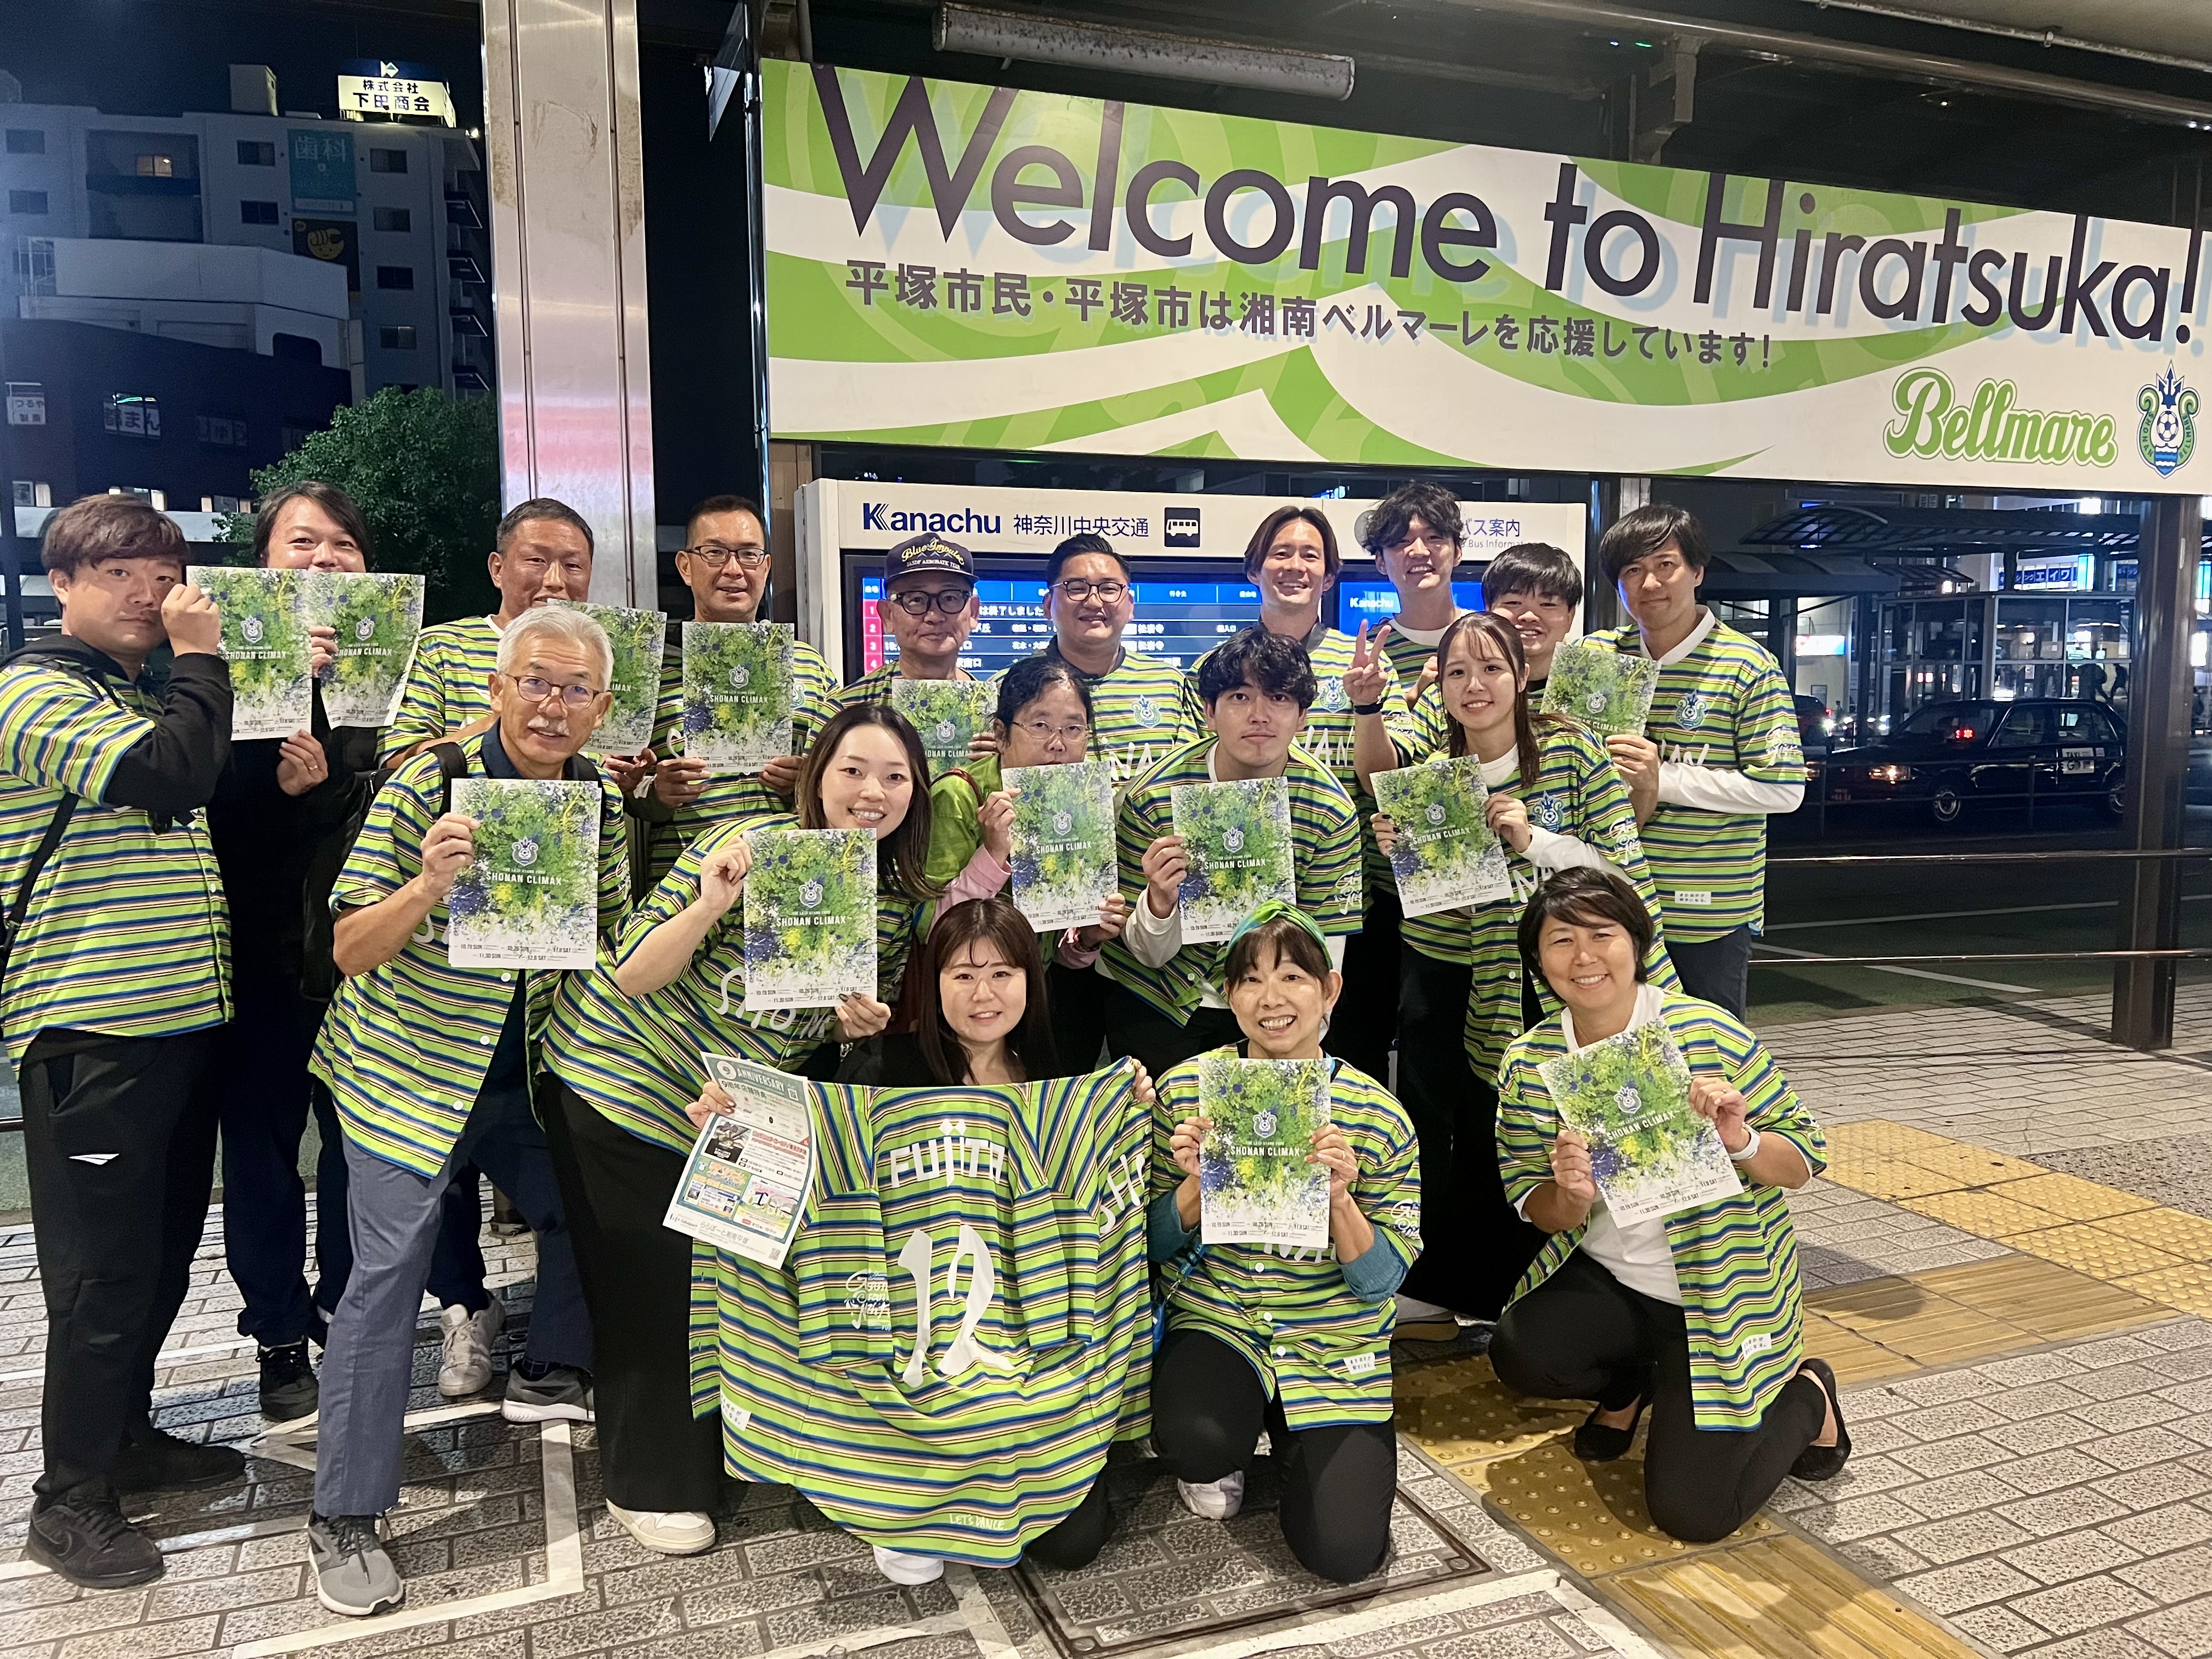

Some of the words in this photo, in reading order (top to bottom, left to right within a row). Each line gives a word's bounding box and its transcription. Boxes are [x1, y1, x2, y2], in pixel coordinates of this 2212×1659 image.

[363, 79, 419, 94] 株式会社
[353, 92, 430, 112] 下田商会
[295, 136, 346, 162] 歯科
[810, 62, 1497, 283] Welcome
[1544, 162, 1660, 297] to
[1694, 172, 2203, 344] Hiratsuka!
[1884, 367, 2118, 468] Bellmare
[863, 503, 1001, 533] Kanachu
[1013, 514, 1149, 538] 神奈川中央交通
[1350, 597, 1394, 608] Kanachu
[870, 624, 876, 633] 2
[335, 648, 362, 657] SHONAN
[364, 647, 392, 657] CLIMAX
[870, 642, 876, 651] 3
[225, 651, 256, 660] SHONAN
[258, 651, 286, 659] CLIMAX
[871, 659, 877, 668] 4
[608, 684, 631, 692] LIMAX
[709, 694, 739, 703] SHONAN
[741, 695, 769, 703] CLIMAX
[1593, 721, 1619, 732] CLIMAX
[948, 749, 973, 758] CLIMA
[1413, 832, 1442, 845] SHONAN
[1443, 827, 1471, 839] CLIMAX
[1036, 843, 1064, 854] SHONAN
[1065, 841, 1092, 851] CLIMAX
[1204, 860, 1235, 870] SHONAN
[1237, 858, 1266, 868] CLIMAX
[486, 871, 523, 883] SHONAN
[527, 875, 562, 885] CLIMAX
[776, 916, 811, 927] SHONAN
[814, 915, 846, 926] CLIMAX
[723, 1066, 731, 1075] 9
[737, 1068, 785, 1092] ANNIVERSARY
[1606, 1122, 1641, 1141] SHONAN
[1641, 1110, 1675, 1128] CLIMAX
[1231, 1146, 1265, 1156] SHONAN
[1267, 1147, 1300, 1156] CLIMAX
[898, 1224, 1015, 1387] 12
